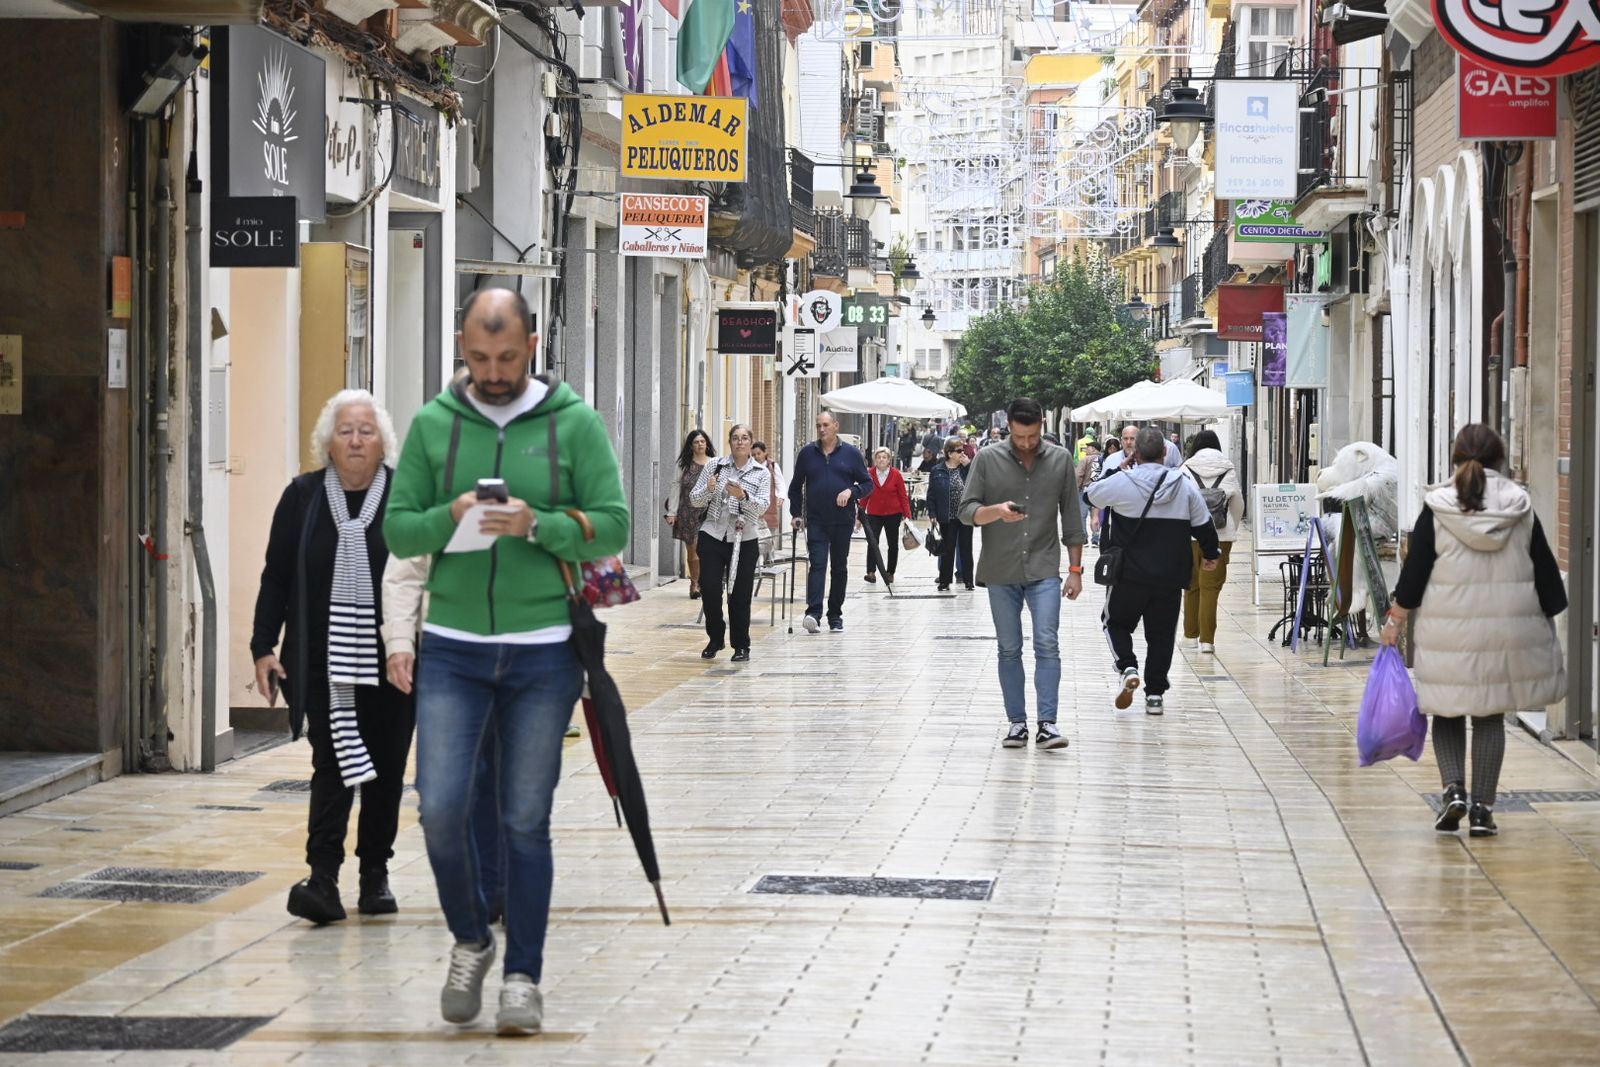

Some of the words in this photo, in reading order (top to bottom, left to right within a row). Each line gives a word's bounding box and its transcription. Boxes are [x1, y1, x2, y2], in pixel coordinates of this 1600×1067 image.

[1464, 69, 1551, 96] GAES
[1508, 98, 1550, 109] amplifon
[628, 102, 741, 137] ALDEMAR
[263, 140, 289, 185] SOLE
[626, 145, 739, 172] PELUQUEROS
[1230, 154, 1284, 165] Inmobiliaria
[624, 212, 704, 225] PELUQUERIA
[1242, 226, 1276, 234] CENTRO
[214, 230, 284, 247] SOLE
[622, 240, 669, 252] Caballeros
[671, 245, 677, 255] y
[679, 242, 704, 253] Niños
[848, 306, 863, 323] 08
[869, 306, 885, 323] 33
[825, 345, 854, 353] Audika
[1275, 495, 1306, 503] DETOX
